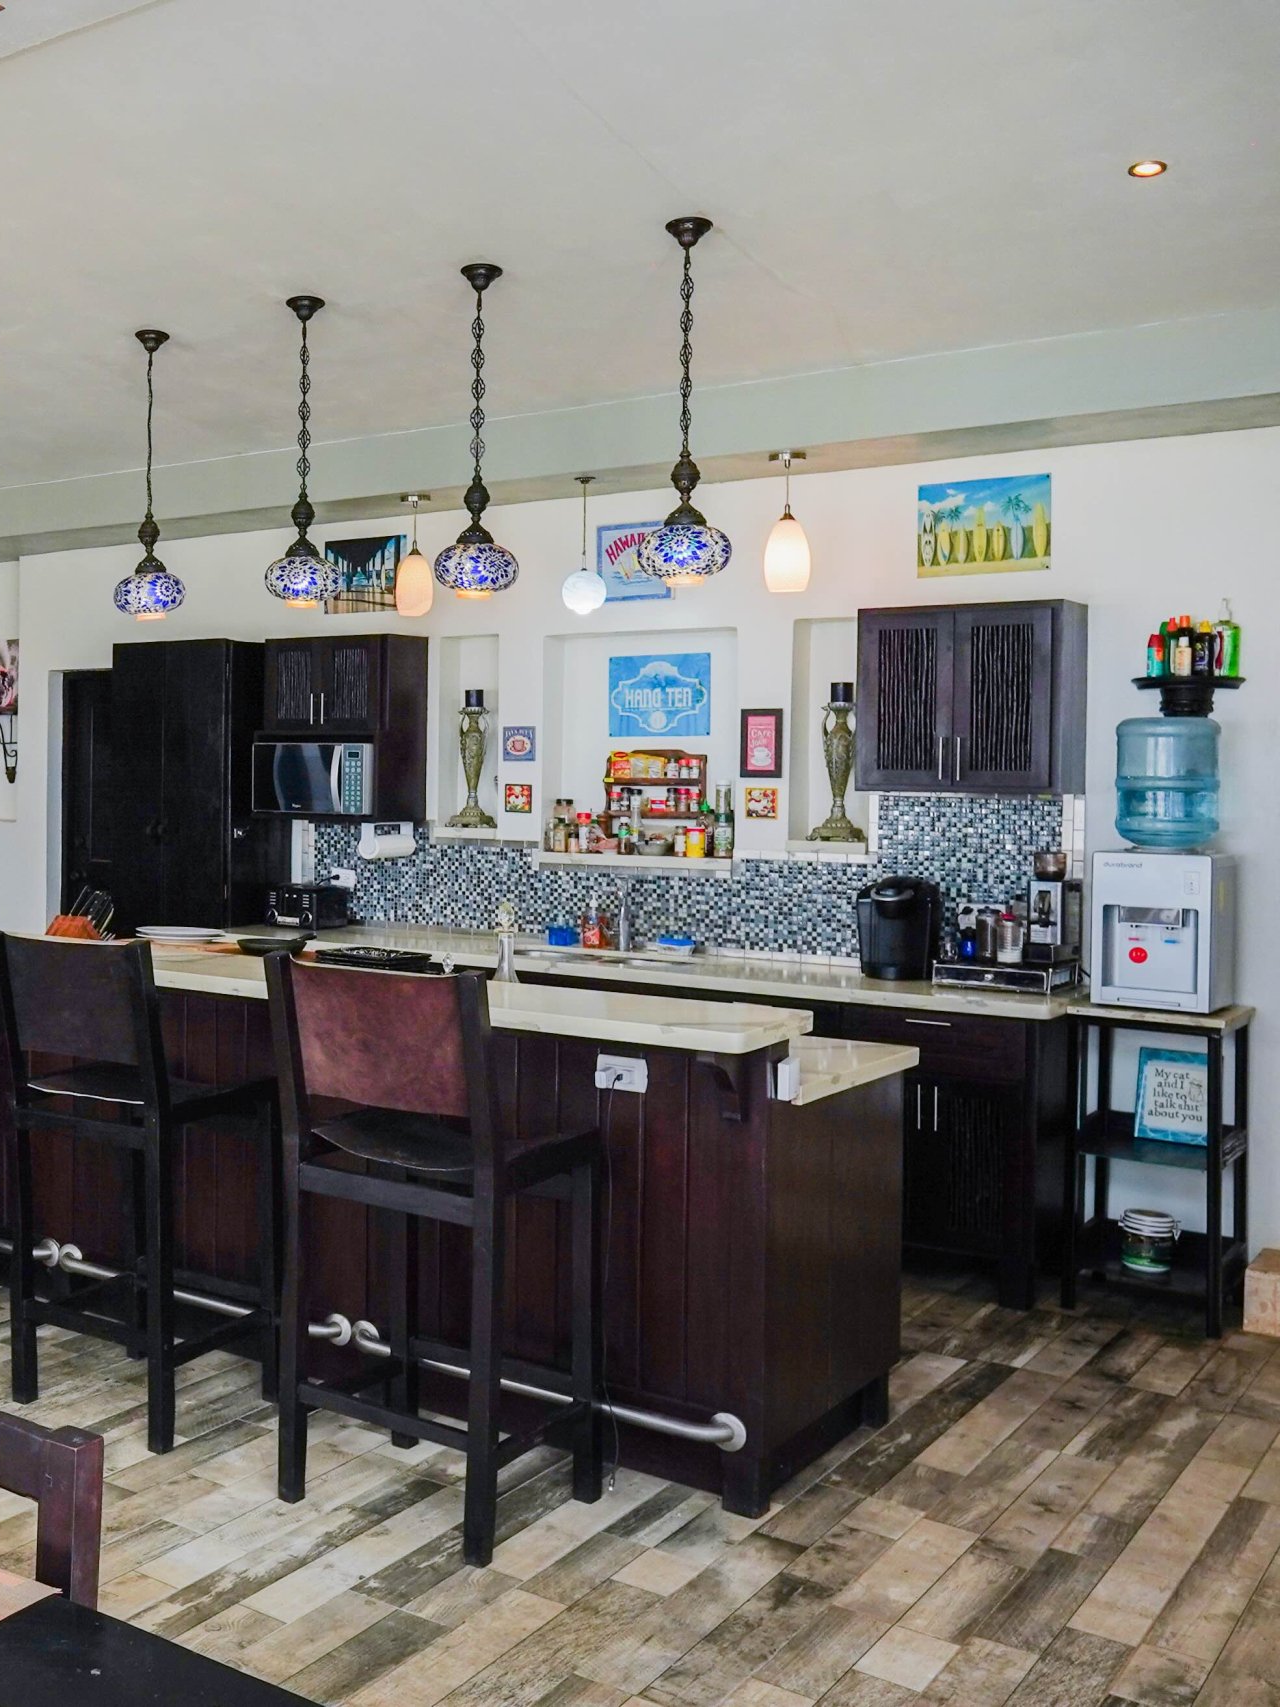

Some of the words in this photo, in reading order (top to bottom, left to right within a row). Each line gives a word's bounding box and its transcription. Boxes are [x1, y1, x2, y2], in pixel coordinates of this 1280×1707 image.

[625, 687, 661, 708] HANG
[666, 687, 692, 708] TEN
[1154, 1067, 1171, 1079] My
[1173, 1071, 1190, 1080] cat
[1157, 1079, 1177, 1089] and
[1179, 1080, 1184, 1090] I
[1153, 1088, 1174, 1099] like
[1176, 1092, 1187, 1101] to
[1154, 1100, 1177, 1109] talk
[1178, 1101, 1199, 1112] shit
[1147, 1108, 1179, 1118] about
[1182, 1114, 1203, 1123] you
